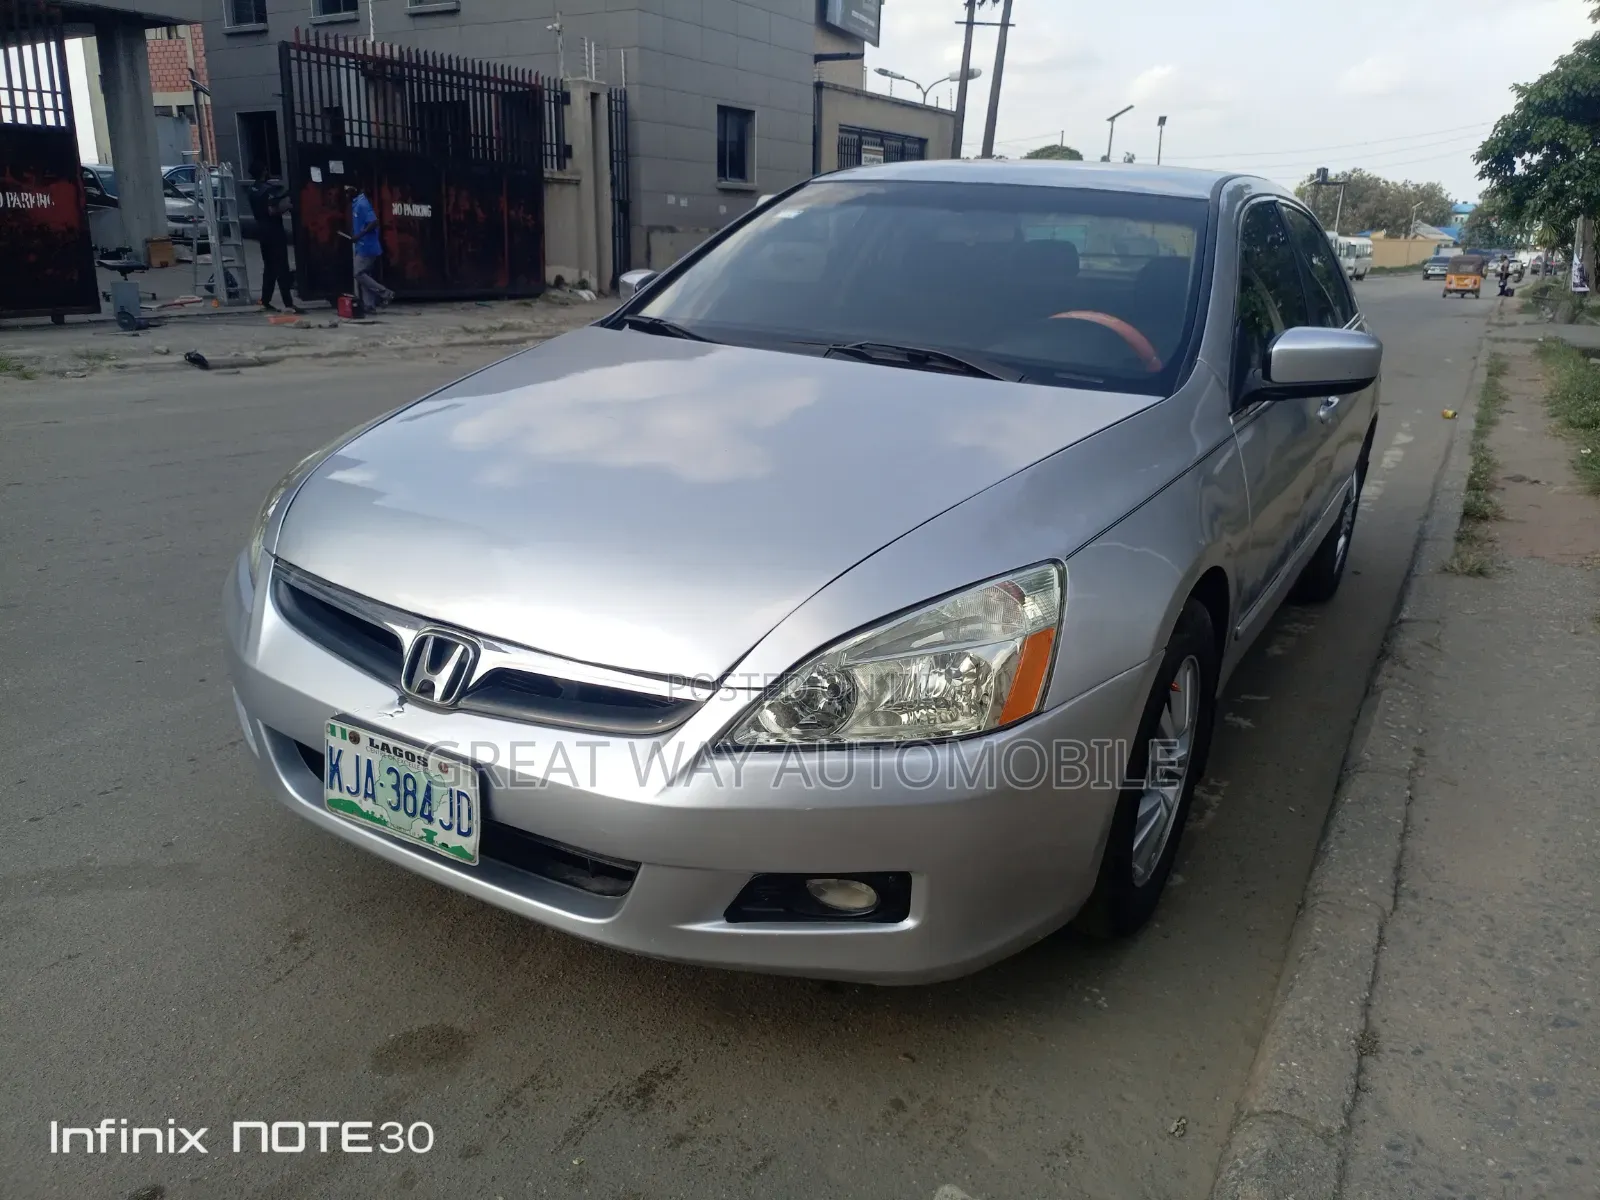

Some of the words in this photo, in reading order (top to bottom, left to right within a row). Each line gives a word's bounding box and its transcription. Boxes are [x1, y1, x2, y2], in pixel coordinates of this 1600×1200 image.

[392, 202, 403, 216] NO
[403, 203, 432, 217] PARKING
[368, 737, 429, 768] LAGOS
